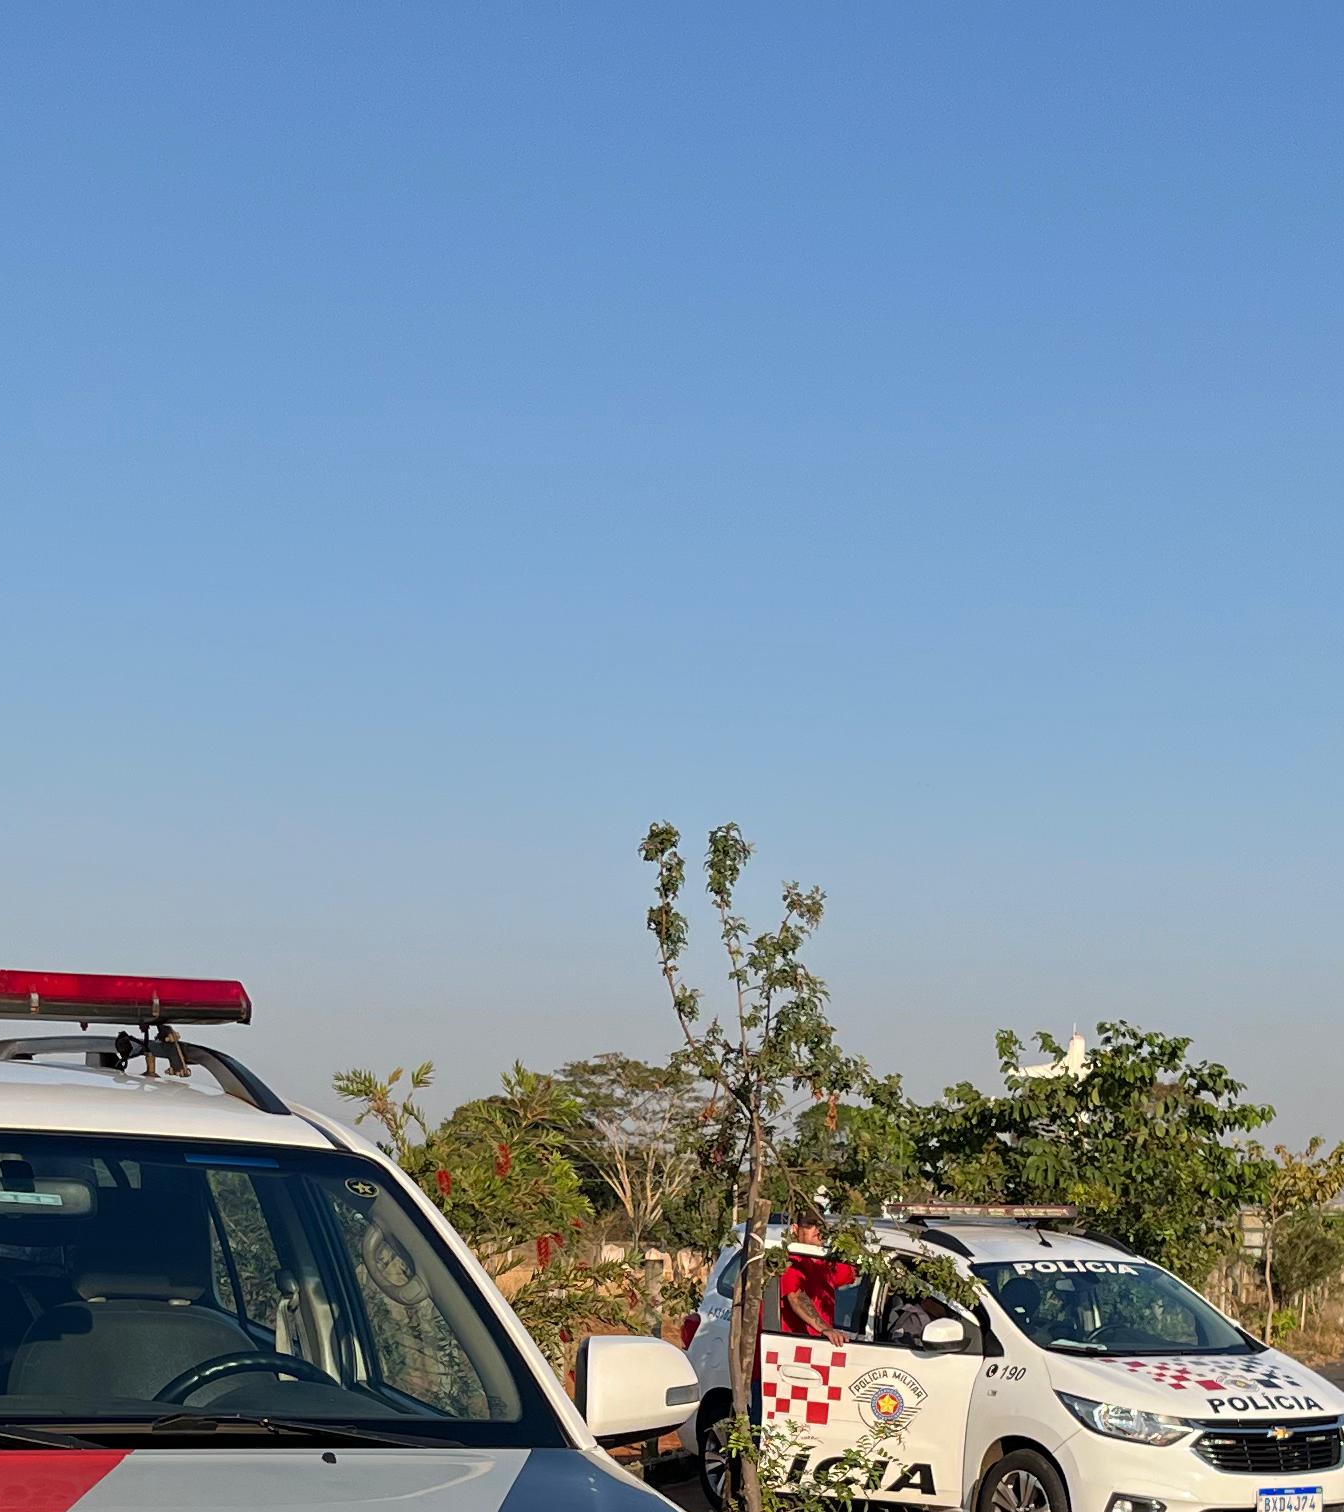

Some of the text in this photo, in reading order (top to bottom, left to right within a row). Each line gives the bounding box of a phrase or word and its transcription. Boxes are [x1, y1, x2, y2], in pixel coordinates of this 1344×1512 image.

[1013, 1260, 1139, 1276] POLÍCIA
[1000, 1365, 1027, 1381] 190
[892, 1371, 924, 1399] MILITAR
[1206, 1392, 1324, 1413] POLÍCIA
[1264, 1495, 1315, 1512] BXD4J74
